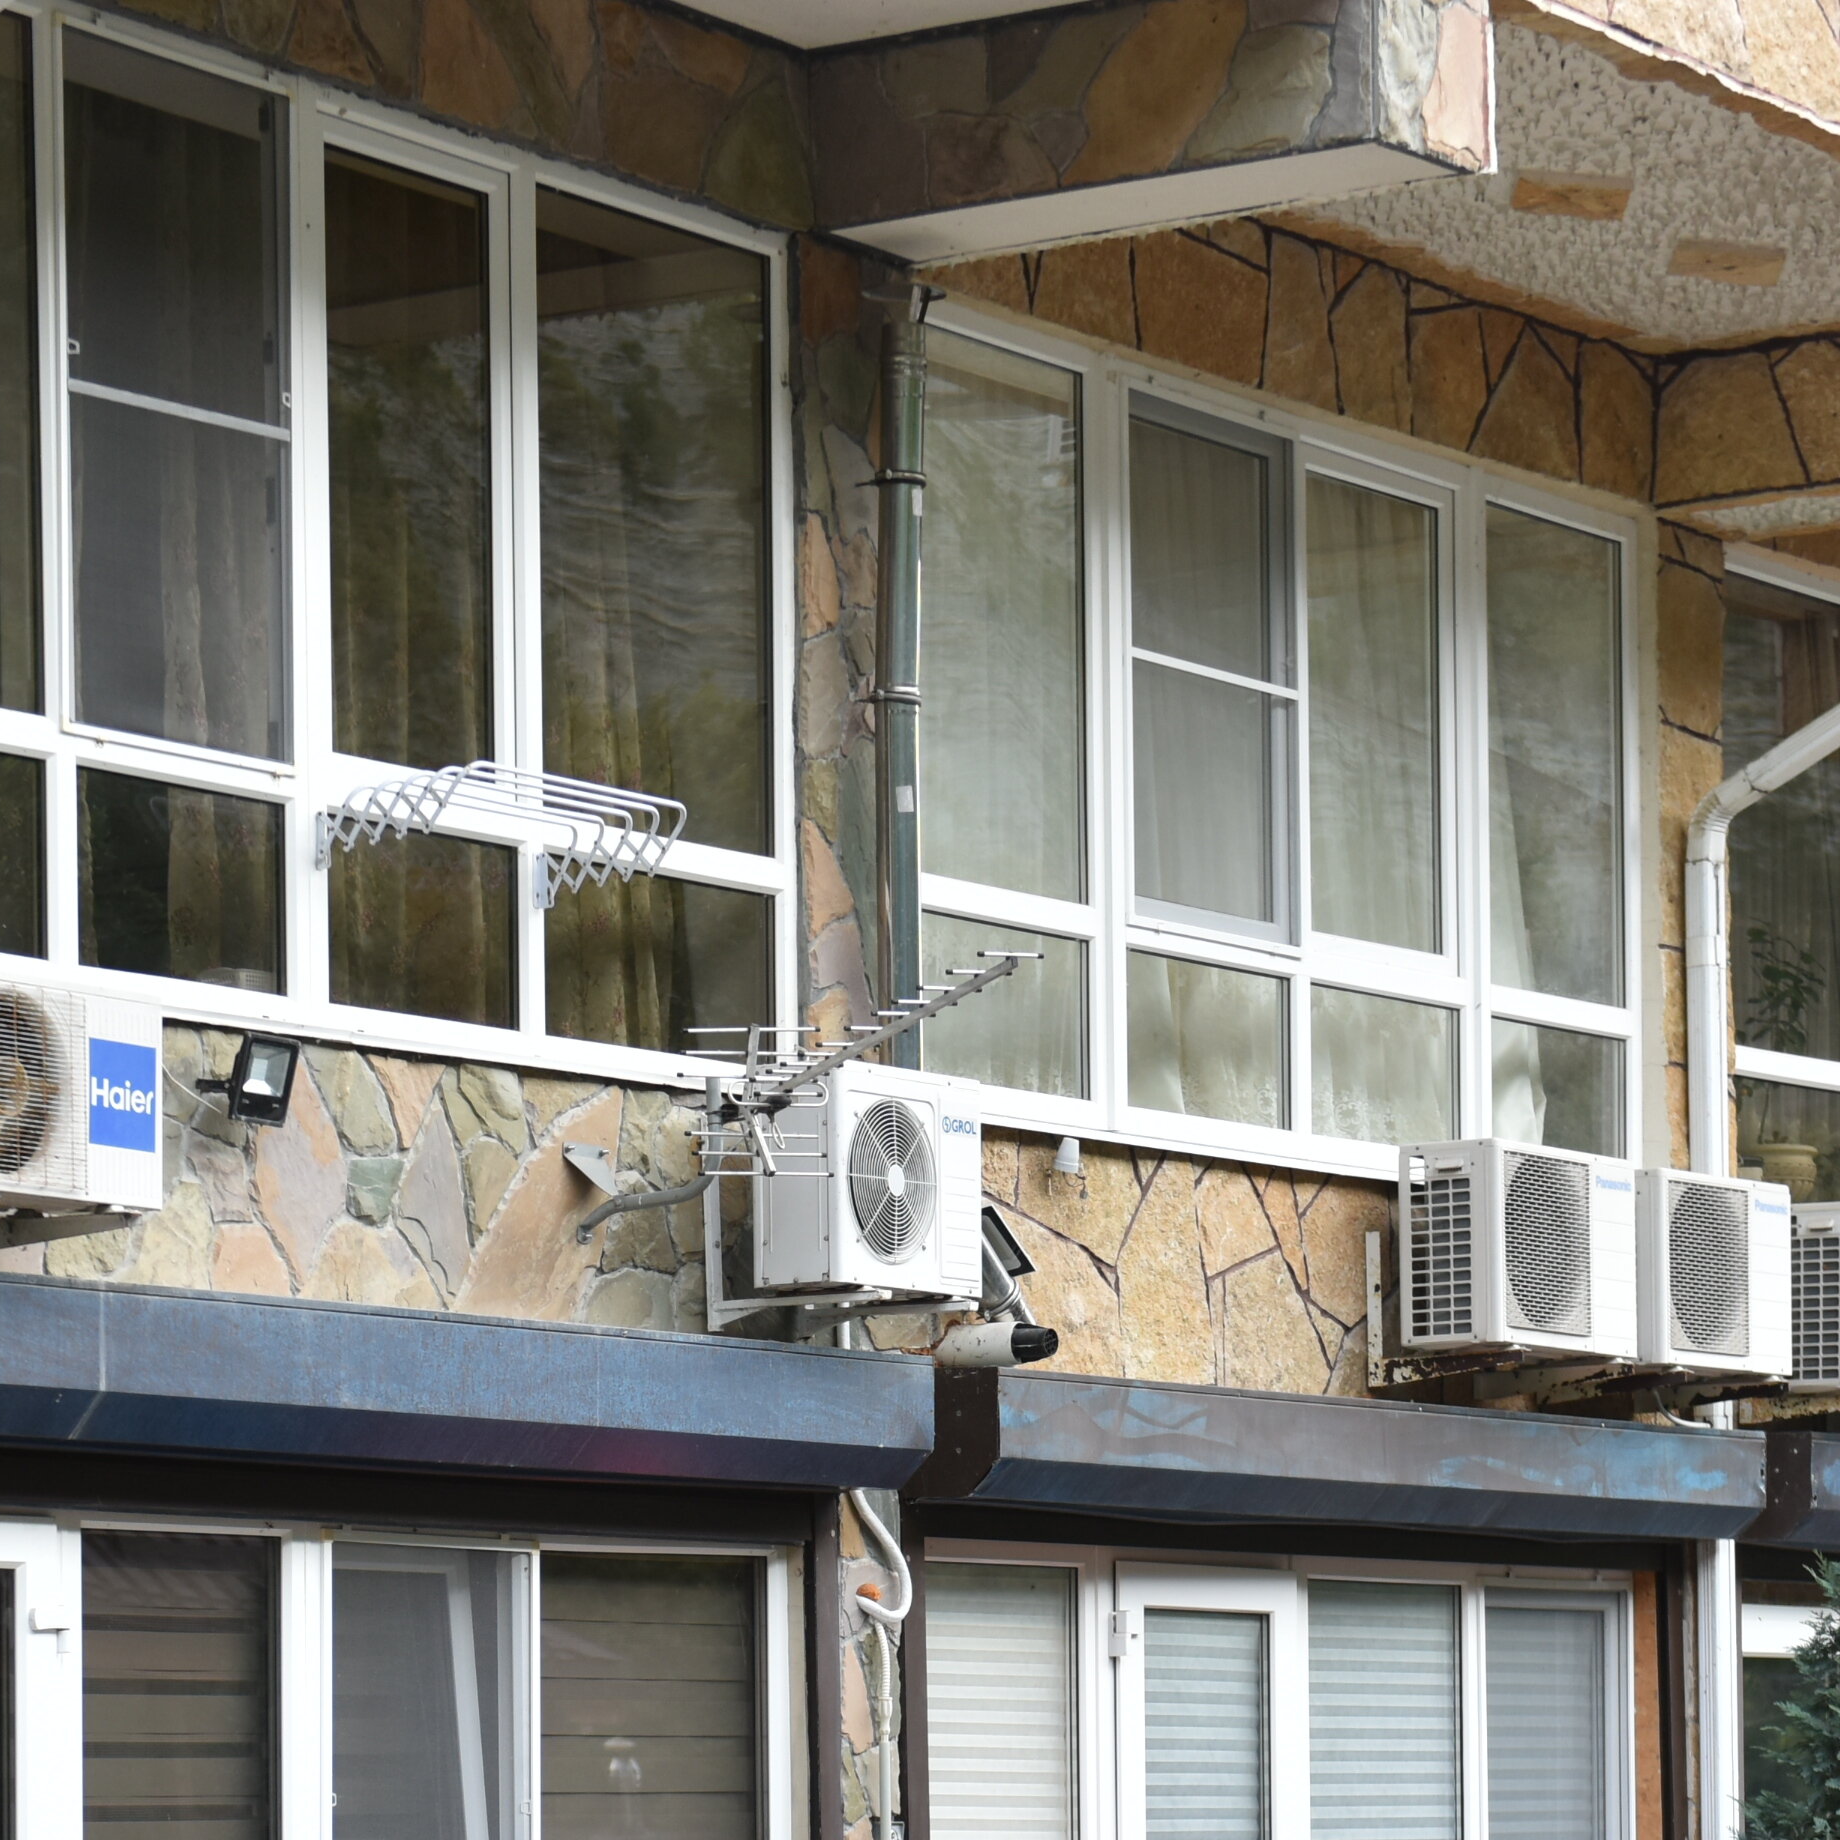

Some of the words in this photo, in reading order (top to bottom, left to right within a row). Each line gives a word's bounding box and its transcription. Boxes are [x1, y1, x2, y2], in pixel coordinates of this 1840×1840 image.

[91, 1076, 154, 1115] Haier
[1596, 1175, 1632, 1192] Panasonic
[1754, 1199, 1788, 1215] Panasonic
